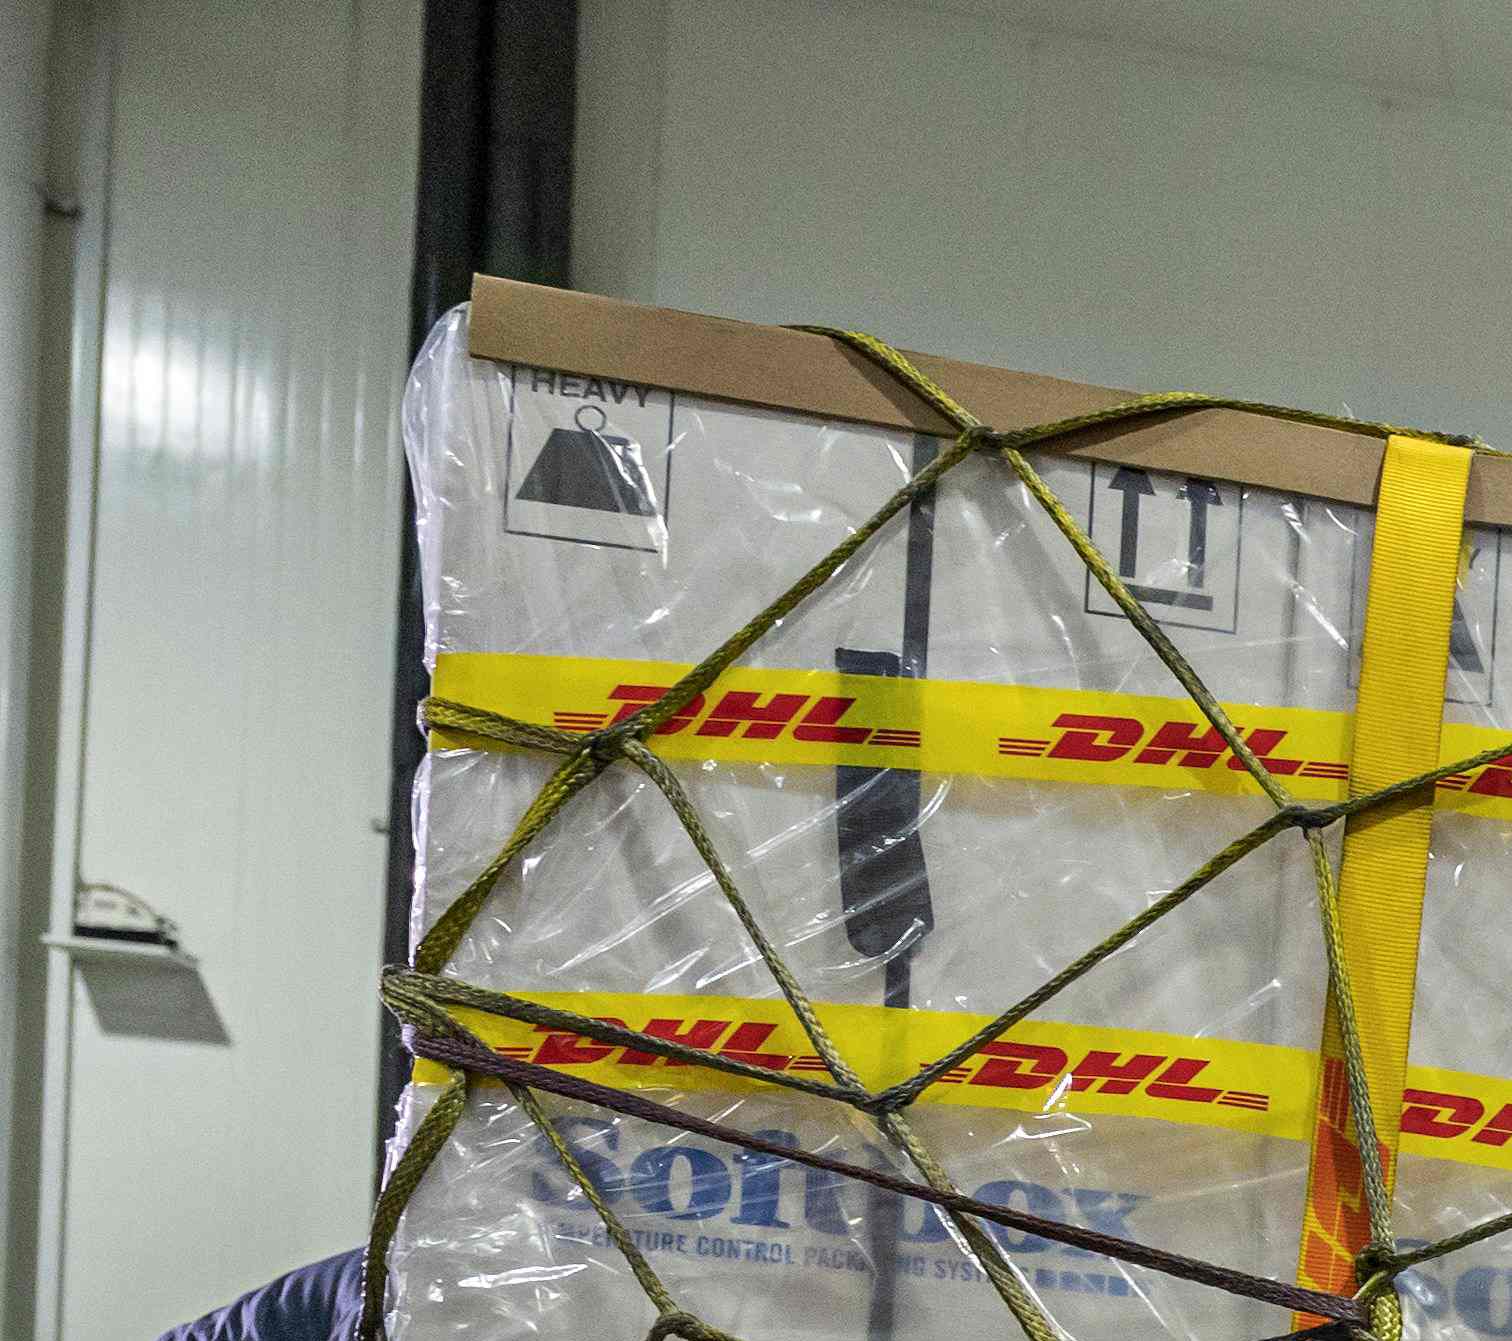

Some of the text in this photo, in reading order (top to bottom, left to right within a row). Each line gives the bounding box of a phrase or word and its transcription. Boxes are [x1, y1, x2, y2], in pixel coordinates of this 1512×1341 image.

[532, 370, 650, 407] HEAVY
[612, 686, 870, 742] DHL
[1050, 716, 1300, 774] DHL
[971, 1042, 1220, 1101] DHL
[696, 1234, 795, 1265] CONTROL
